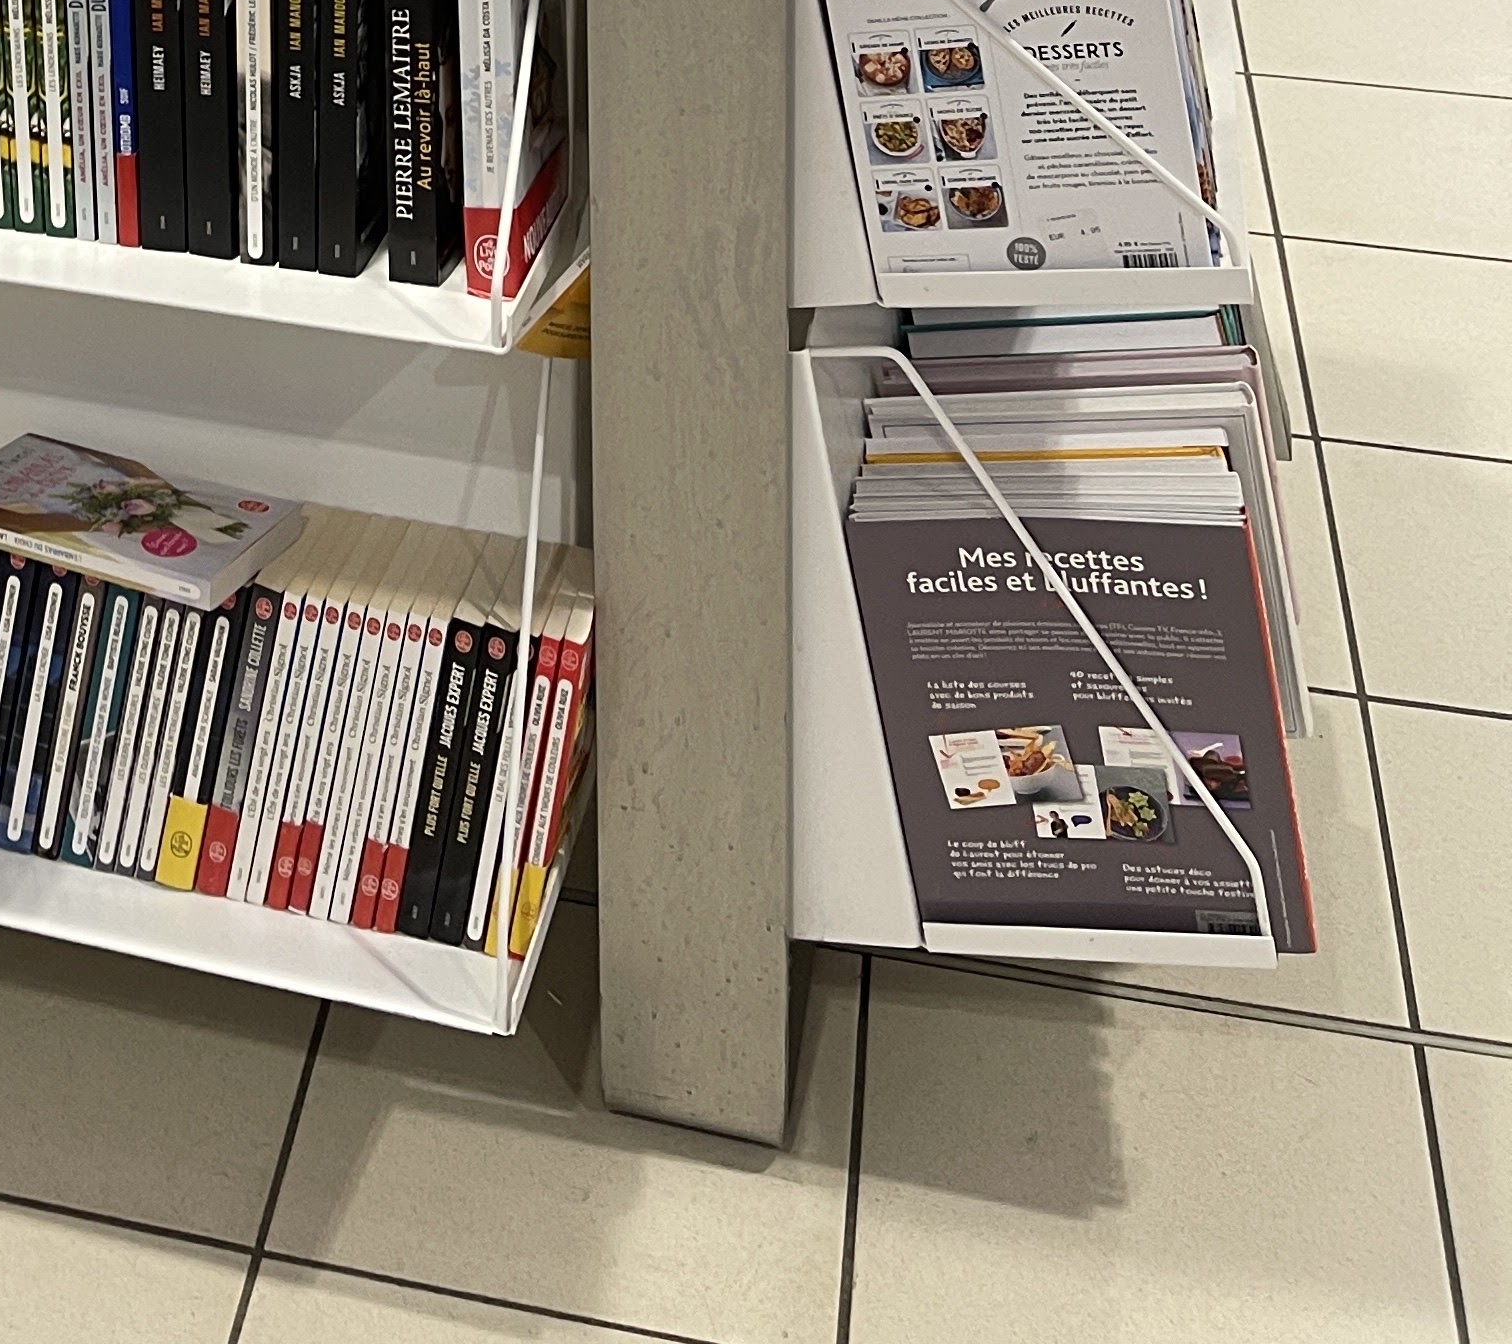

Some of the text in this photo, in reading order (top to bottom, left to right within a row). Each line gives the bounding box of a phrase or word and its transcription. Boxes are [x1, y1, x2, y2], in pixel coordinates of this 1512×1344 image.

[151, 11, 163, 32] IAN
[1004, 5, 1136, 33] LES MEILLEURES RECETTES
[1022, 41, 1125, 62] DESSERTS
[153, 45, 166, 91] HEIMAEY
[392, 8, 414, 221] PIERRE LEMAITRE
[414, 42, 435, 191] Au revoir là-haut
[958, 547, 1017, 569] Mes
[907, 570, 998, 594] faciles
[1006, 572, 1035, 593] et
